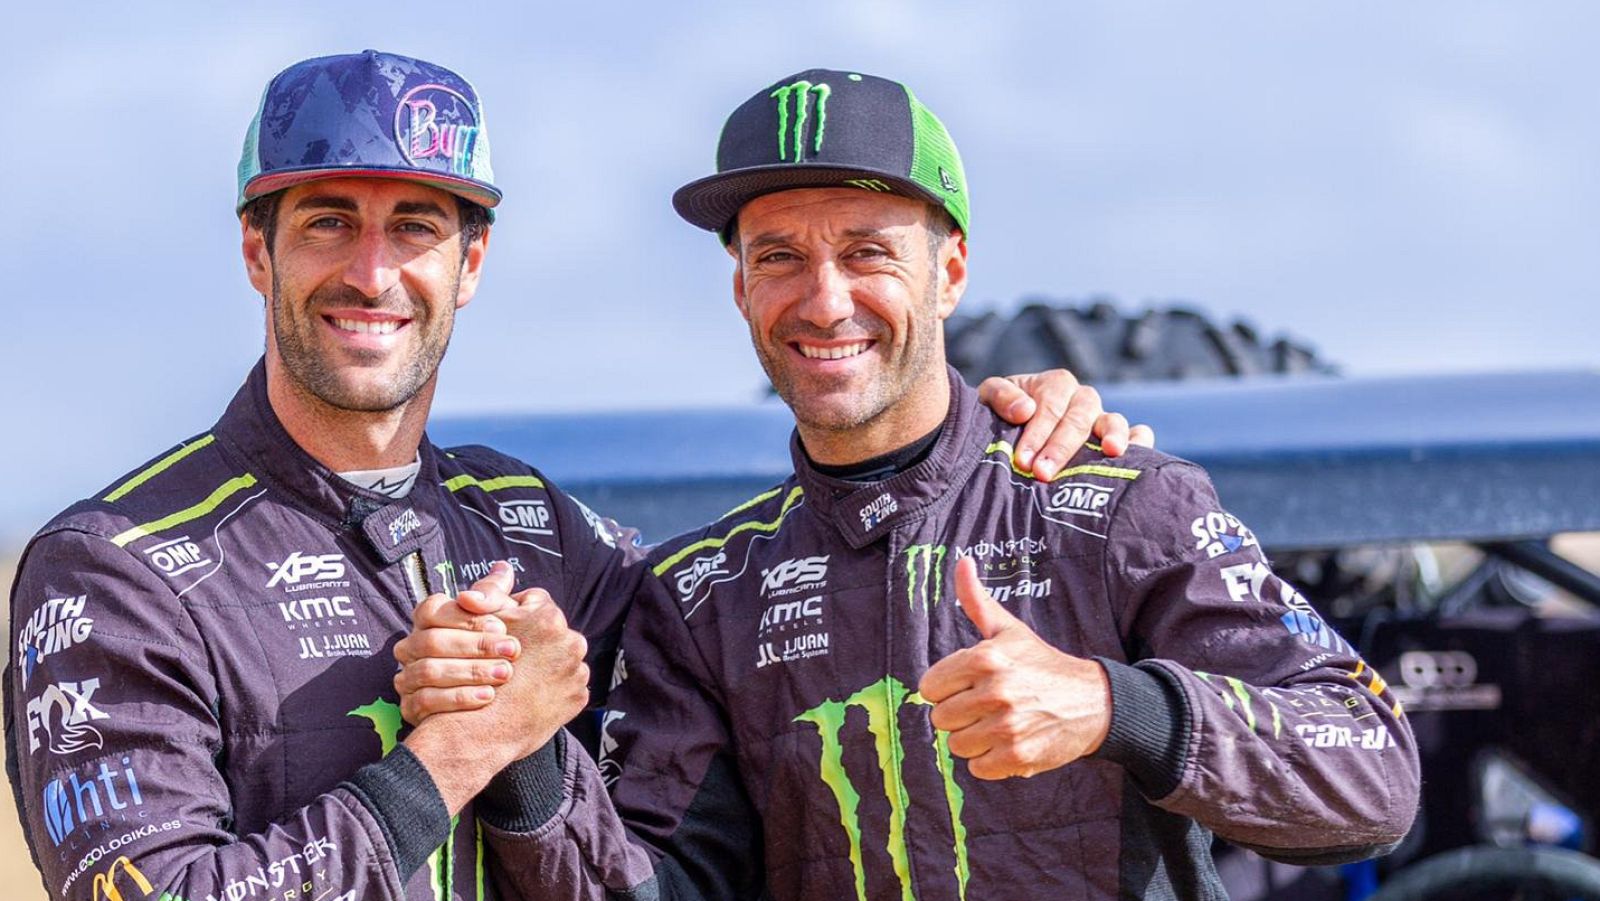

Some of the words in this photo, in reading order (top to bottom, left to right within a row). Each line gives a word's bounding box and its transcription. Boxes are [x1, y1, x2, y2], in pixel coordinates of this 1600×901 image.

[860, 493, 890, 522] SOUTH
[1051, 487, 1109, 510] OMP
[500, 506, 550, 528] OMP
[152, 541, 201, 571] OMP
[265, 552, 345, 588] XPS
[285, 581, 350, 593] LUBRICANTS
[677, 552, 727, 594] OMP
[760, 554, 830, 596] XPS
[19, 595, 87, 666] SOUTH
